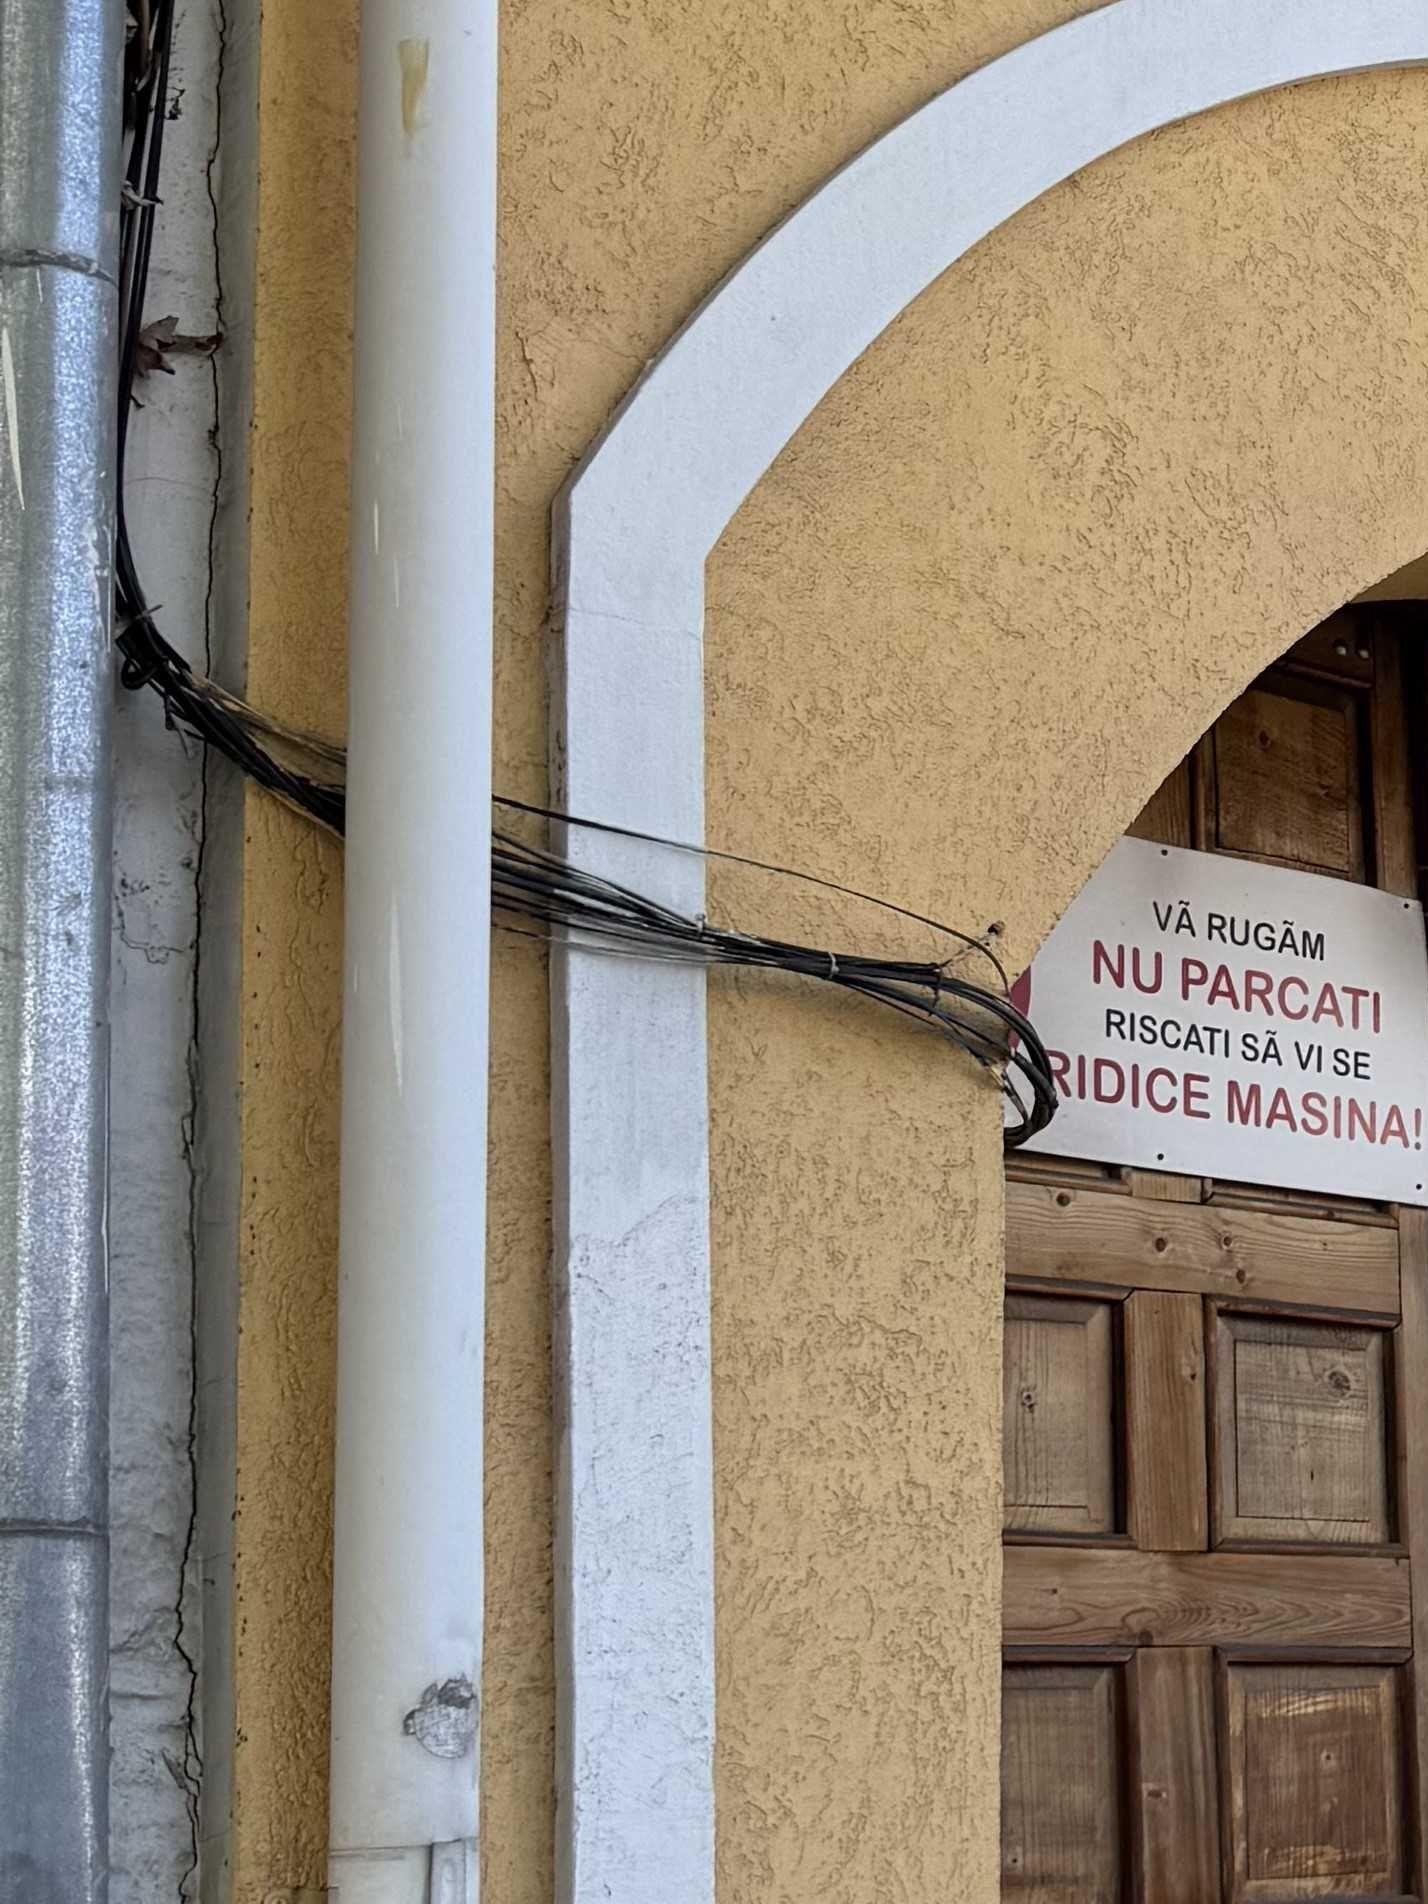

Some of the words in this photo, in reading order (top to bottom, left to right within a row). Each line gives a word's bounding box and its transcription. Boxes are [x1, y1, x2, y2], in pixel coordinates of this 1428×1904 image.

[1092, 939, 1163, 995] NU
[1181, 957, 1381, 1034] PARCATI
[1105, 1008, 1230, 1059] RISCATI
[1293, 1040, 1323, 1074] VI
[1332, 1047, 1372, 1081] SE
[1044, 1049, 1211, 1120] RIDICE
[1227, 1079, 1422, 1151] MASINA!
